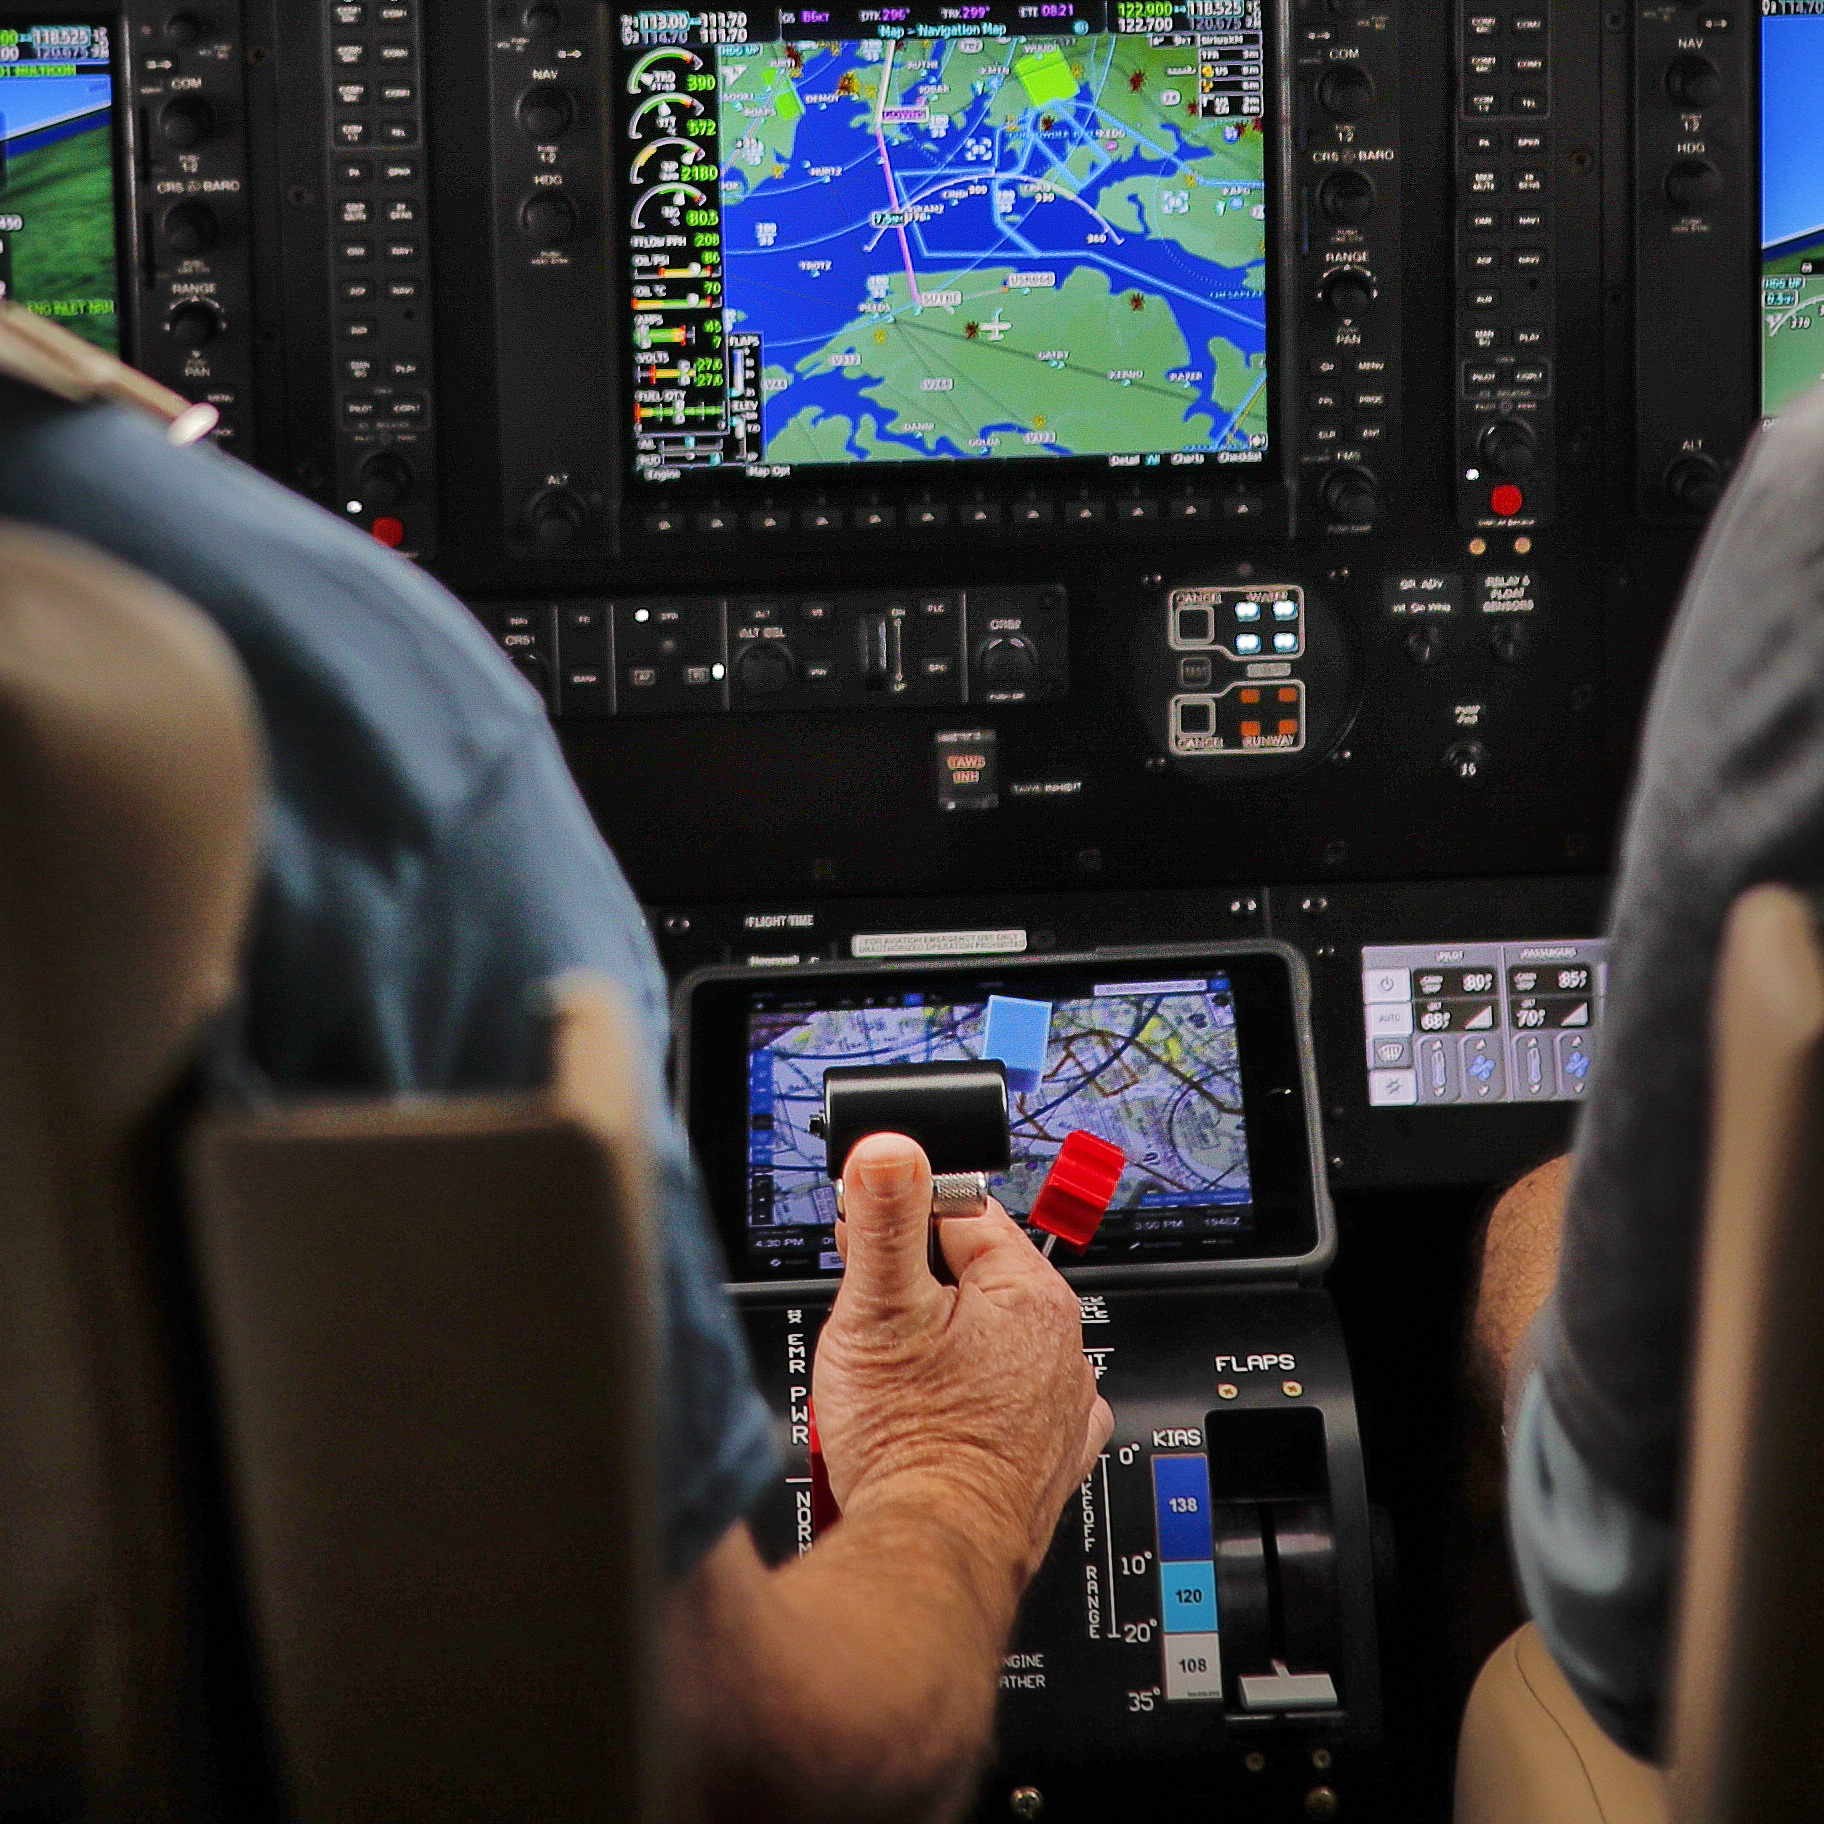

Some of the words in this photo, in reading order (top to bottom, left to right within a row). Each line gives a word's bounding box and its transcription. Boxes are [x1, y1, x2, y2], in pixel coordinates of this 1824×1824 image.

[1186, 0, 1242, 16] 118.525
[700, 12, 747, 28] 111.70
[1118, 18, 1173, 32] 122.700
[878, 26, 904, 38] Map
[917, 23, 980, 38] Navigation
[982, 22, 1006, 37] Map
[1678, 38, 1703, 49] NAV
[1329, 48, 1359, 60] COM
[533, 69, 558, 81] NAV
[171, 78, 202, 89] COM
[687, 74, 716, 91] 390
[1358, 149, 1394, 161] BARO
[1677, 142, 1705, 154] HDG
[534, 175, 562, 186] HDG
[1325, 251, 1368, 263] RANGE
[172, 282, 217, 295] RANGE
[1335, 334, 1361, 345] PAN
[1682, 439, 1703, 450] ALT
[1242, 735, 1295, 748] RUNWAY
[747, 916, 786, 927] FLIGHT
[788, 915, 814, 926] TIME
[1379, 1013, 1400, 1022] AUTO
[788, 1334, 806, 1374] EMR
[1215, 1353, 1295, 1372] FLAPS
[790, 1386, 808, 1445] PWR
[1152, 1430, 1201, 1448] KIAS
[1118, 1443, 1141, 1465] 0°
[1168, 1497, 1198, 1513] 138
[1080, 1482, 1095, 1553] KEOFF
[1121, 1551, 1153, 1575] 10°
[1085, 1566, 1101, 1639] RANGE
[1175, 1589, 1202, 1604] 120
[1124, 1620, 1157, 1643] 20°
[1004, 1654, 1045, 1669] NGINE
[1178, 1659, 1207, 1673] 108
[999, 1675, 1046, 1689] ATHER
[1128, 1688, 1161, 1712] 35°
